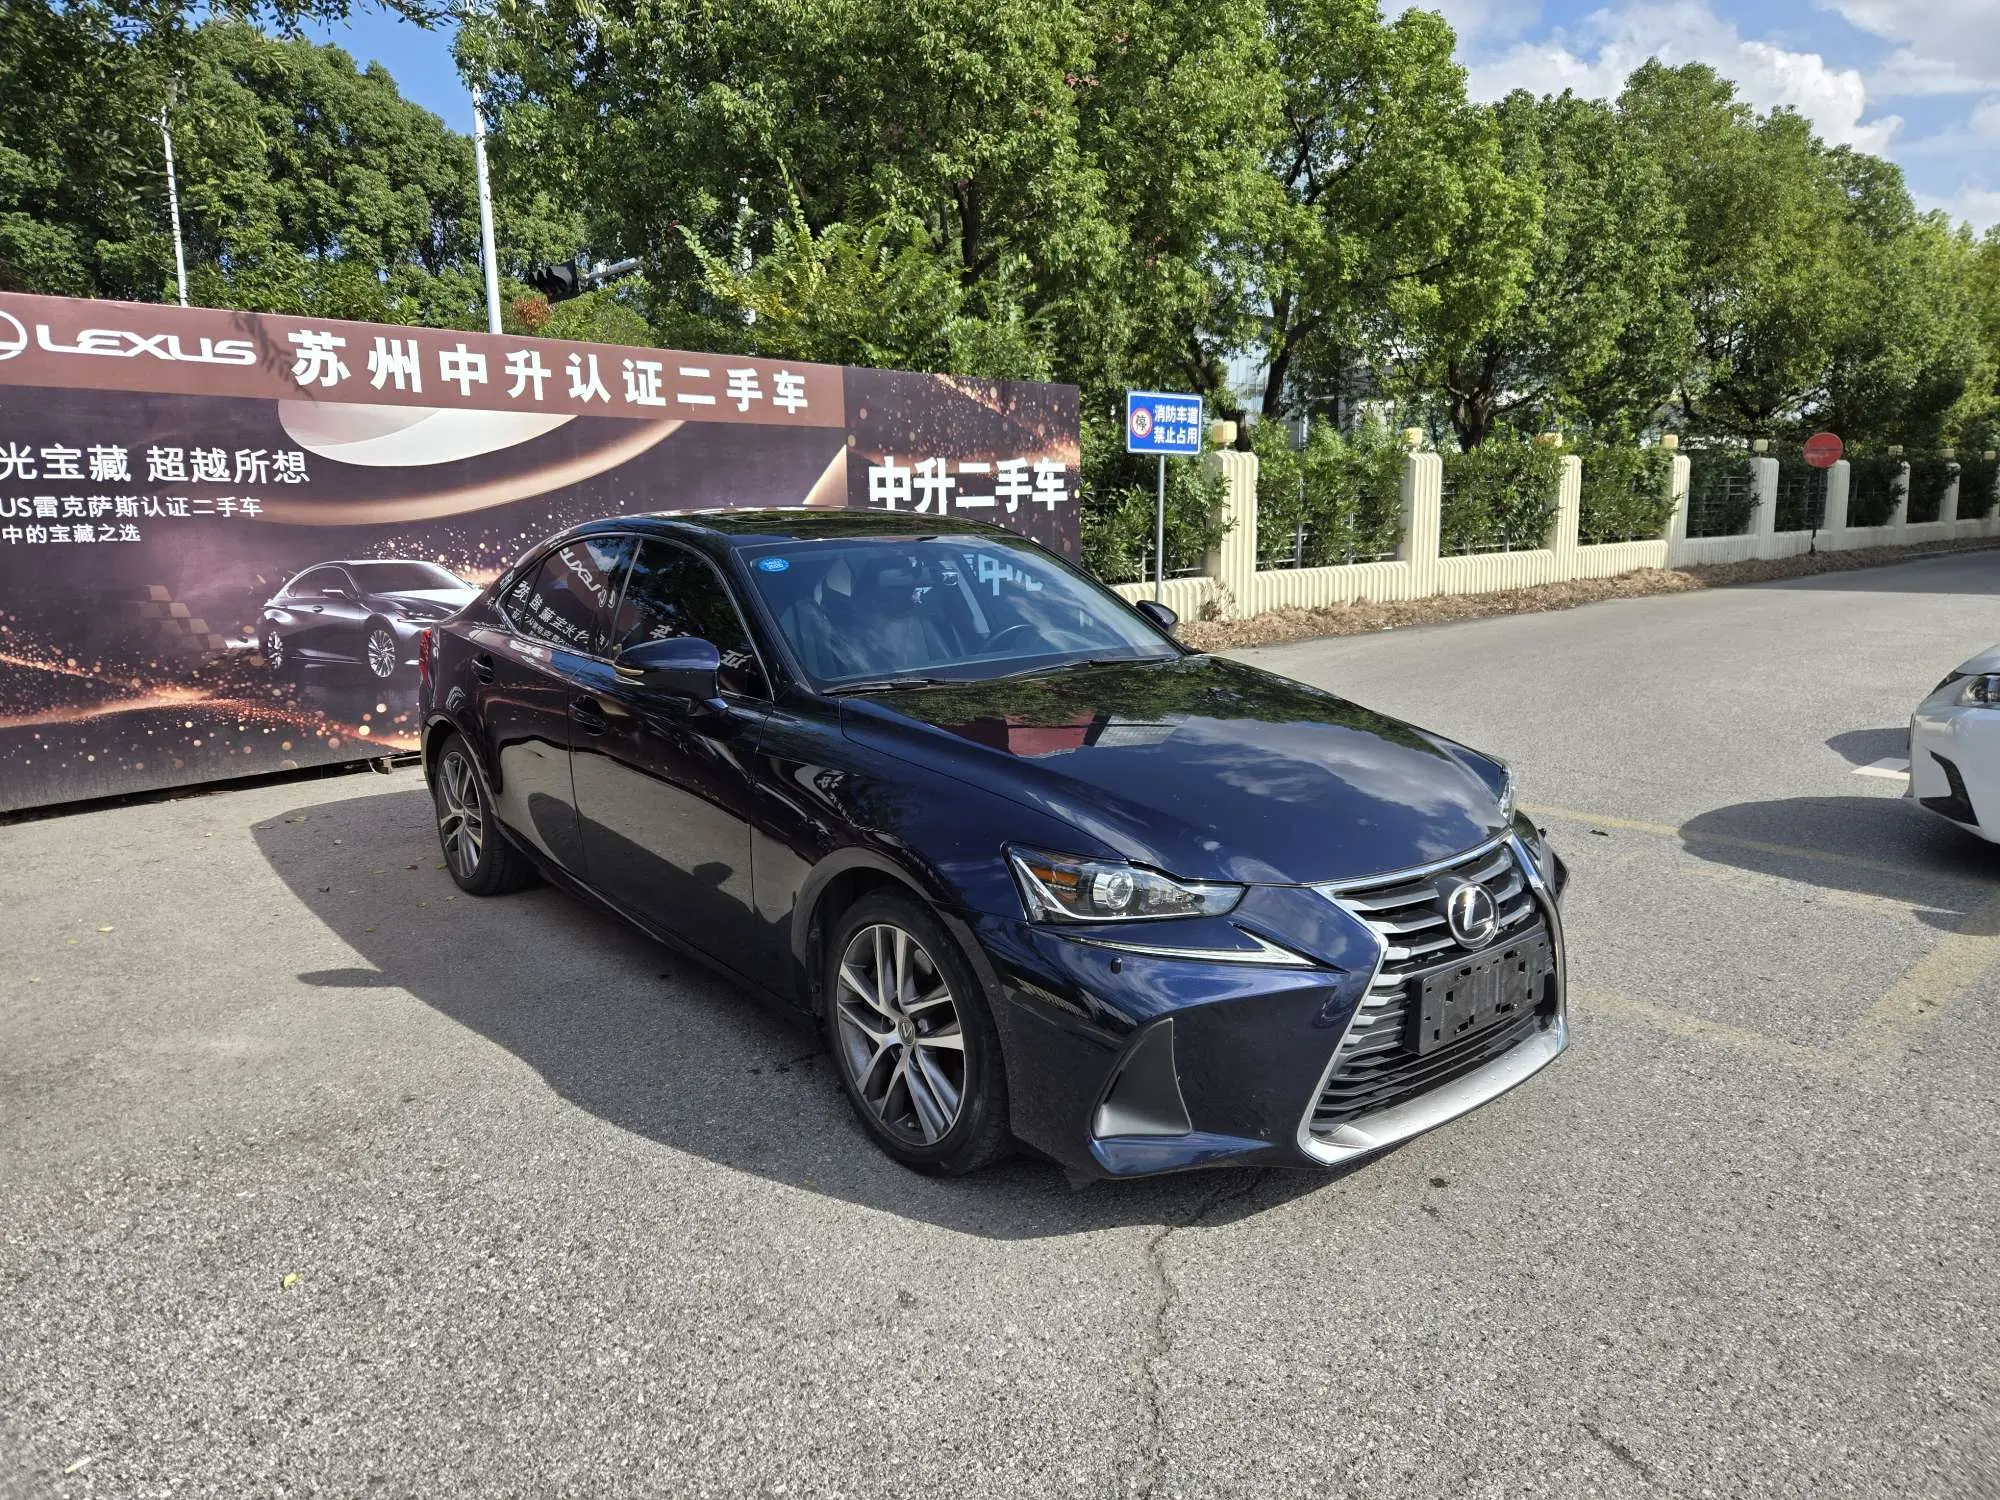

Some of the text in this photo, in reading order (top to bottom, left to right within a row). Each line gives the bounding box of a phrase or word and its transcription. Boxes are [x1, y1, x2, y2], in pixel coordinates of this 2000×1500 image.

[36, 323, 257, 366] LEXUS
[287, 328, 809, 415] 苏州中升认证二手车
[1153, 404, 1199, 425] 消防车道
[1153, 425, 1198, 445] 禁止占用
[146, 445, 311, 485] 超越所想
[868, 454, 1069, 516] 中升二手车
[1, 523, 142, 545] 中的宝藏之选
